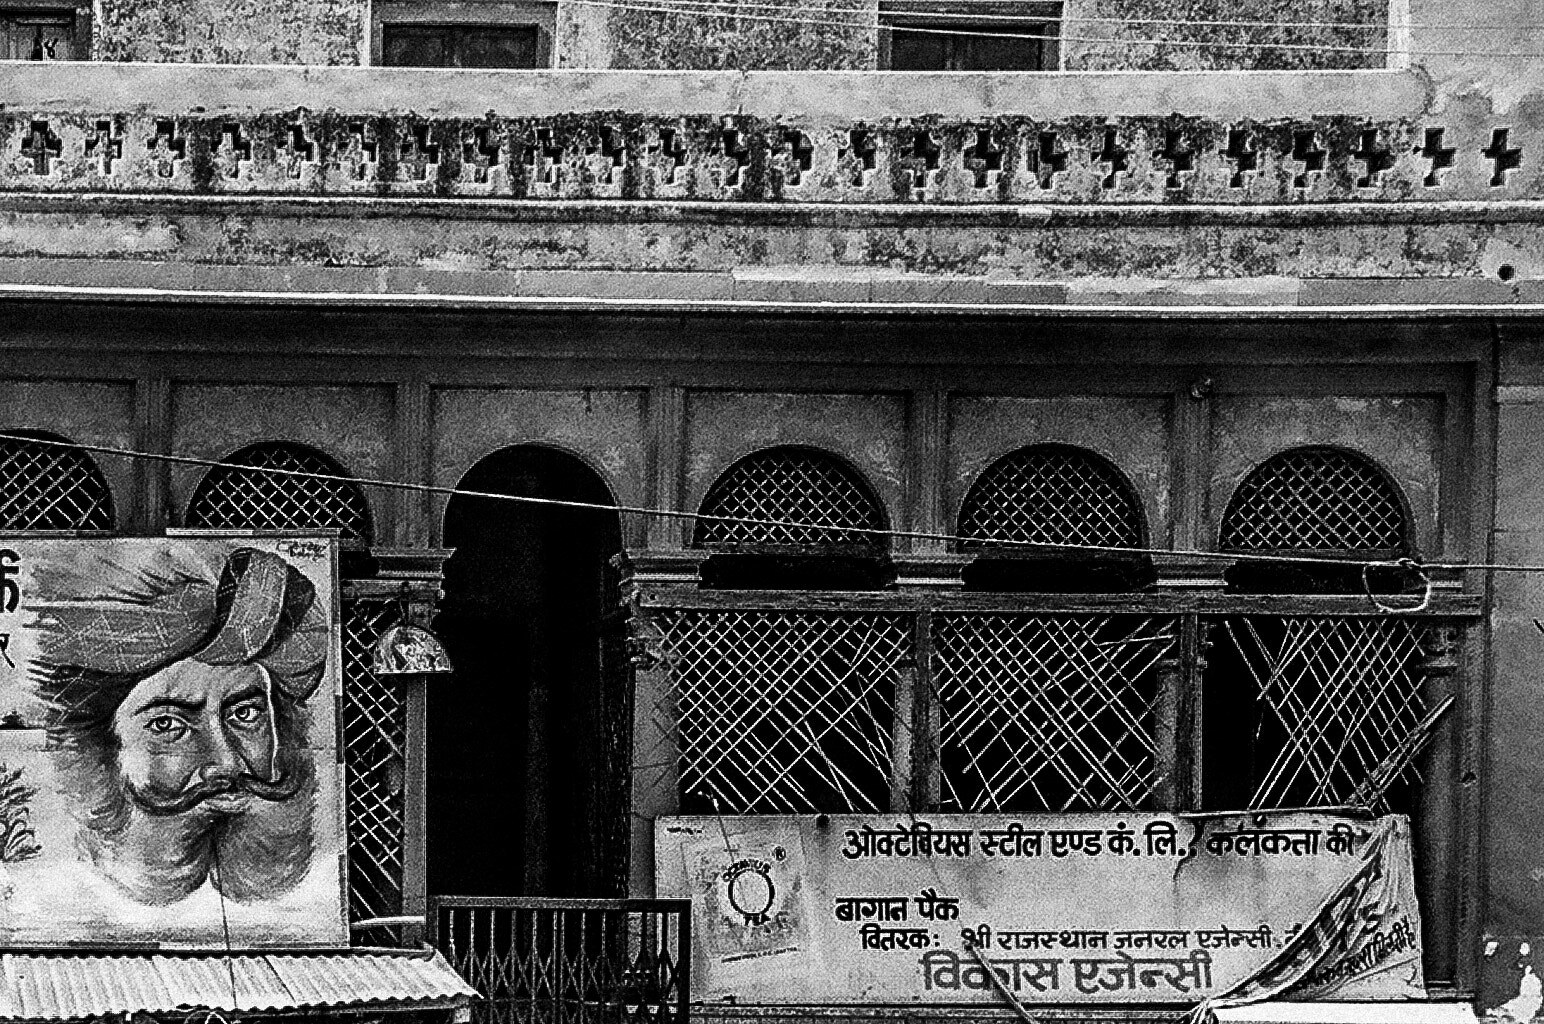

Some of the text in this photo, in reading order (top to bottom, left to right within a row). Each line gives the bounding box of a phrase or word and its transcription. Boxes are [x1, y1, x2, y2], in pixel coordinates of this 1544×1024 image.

[979, 822, 1043, 858] स्टील
[1050, 828, 1103, 858] एण्ड
[834, 887, 960, 923] बागान पैक
[997, 929, 1108, 951] राजस्थान
[1113, 929, 1191, 950] जनरल
[1195, 924, 1273, 950] एजेन्सी
[918, 947, 1214, 994] विकास एजेन्सी
